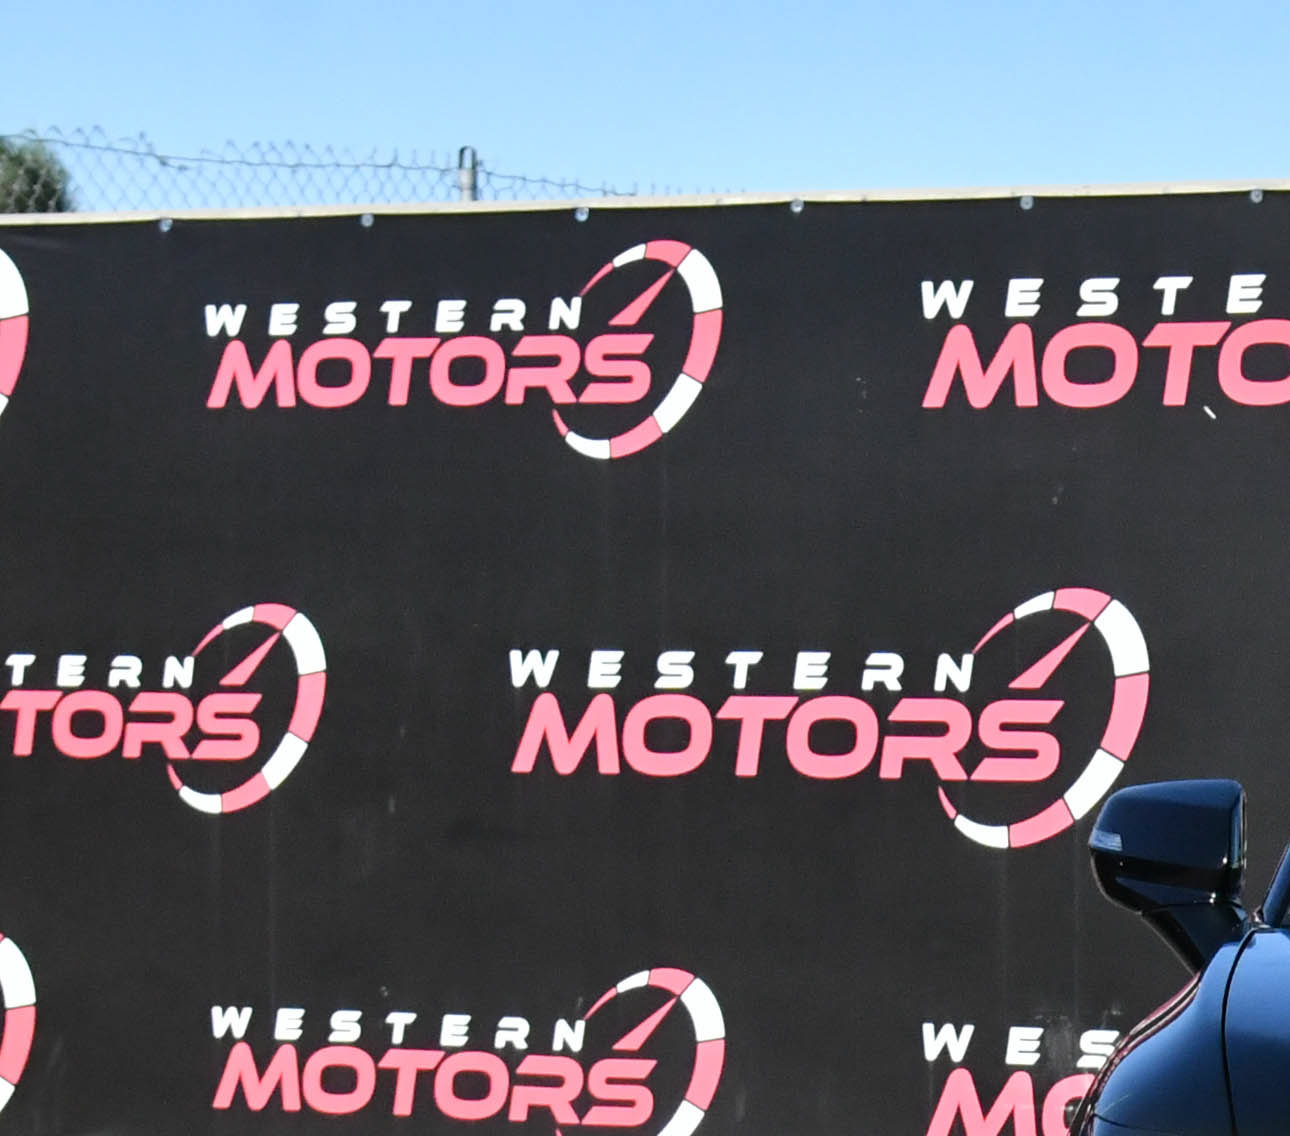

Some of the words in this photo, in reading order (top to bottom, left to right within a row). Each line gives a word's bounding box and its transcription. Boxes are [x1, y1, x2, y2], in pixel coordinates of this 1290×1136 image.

[205, 297, 582, 336] WESTERN
[206, 334, 654, 410] MOTORS
[5, 653, 195, 689] TERN
[509, 649, 975, 693] WESTERN
[511, 692, 1065, 783] MOTORS
[211, 1005, 586, 1053] WESTERN
[212, 1041, 658, 1128] MOTORS
